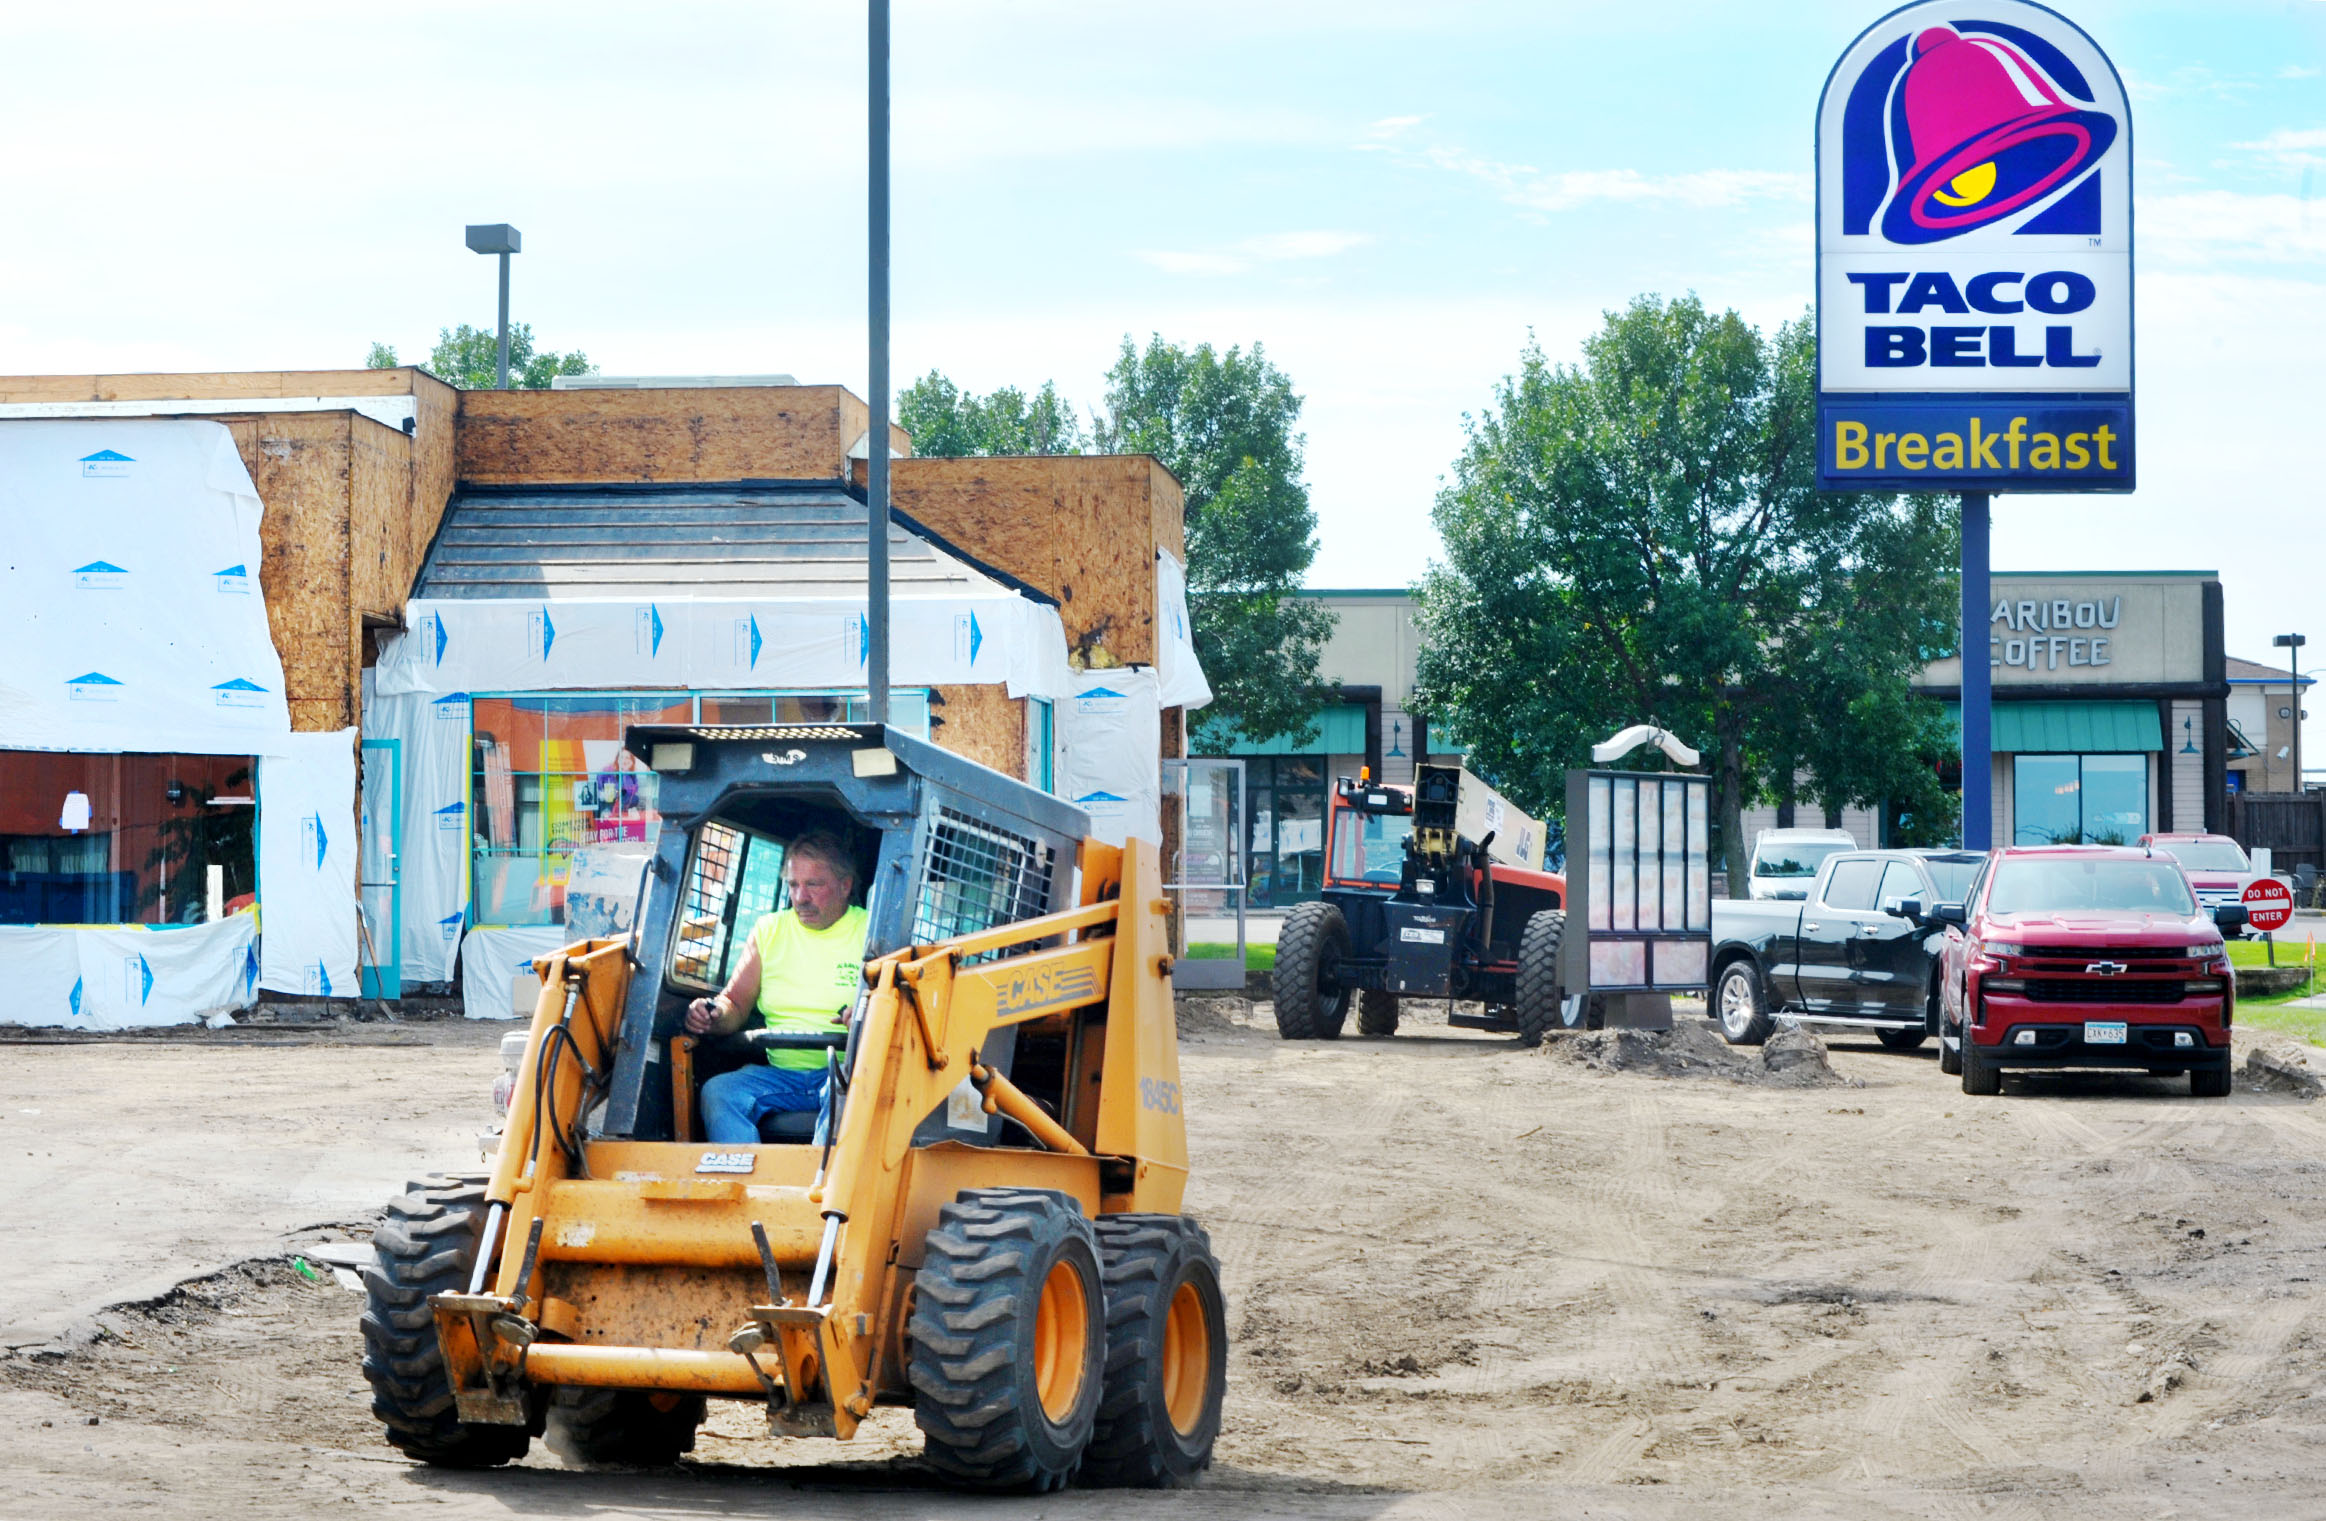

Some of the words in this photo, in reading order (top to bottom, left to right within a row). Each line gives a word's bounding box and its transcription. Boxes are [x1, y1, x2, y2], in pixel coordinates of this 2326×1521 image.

[1846, 271, 2096, 315] TACO
[1865, 326, 2103, 368] BELL
[1835, 417, 2118, 470] Breakfast
[1990, 595, 2121, 634] ARIBOU
[2247, 889, 2261, 899] DO
[2264, 887, 2284, 898] NOT
[2252, 911, 2283, 922] ENTER
[1006, 961, 1065, 1010] CASE
[1139, 1076, 1180, 1116] 1845C
[700, 1152, 756, 1166] CASE
